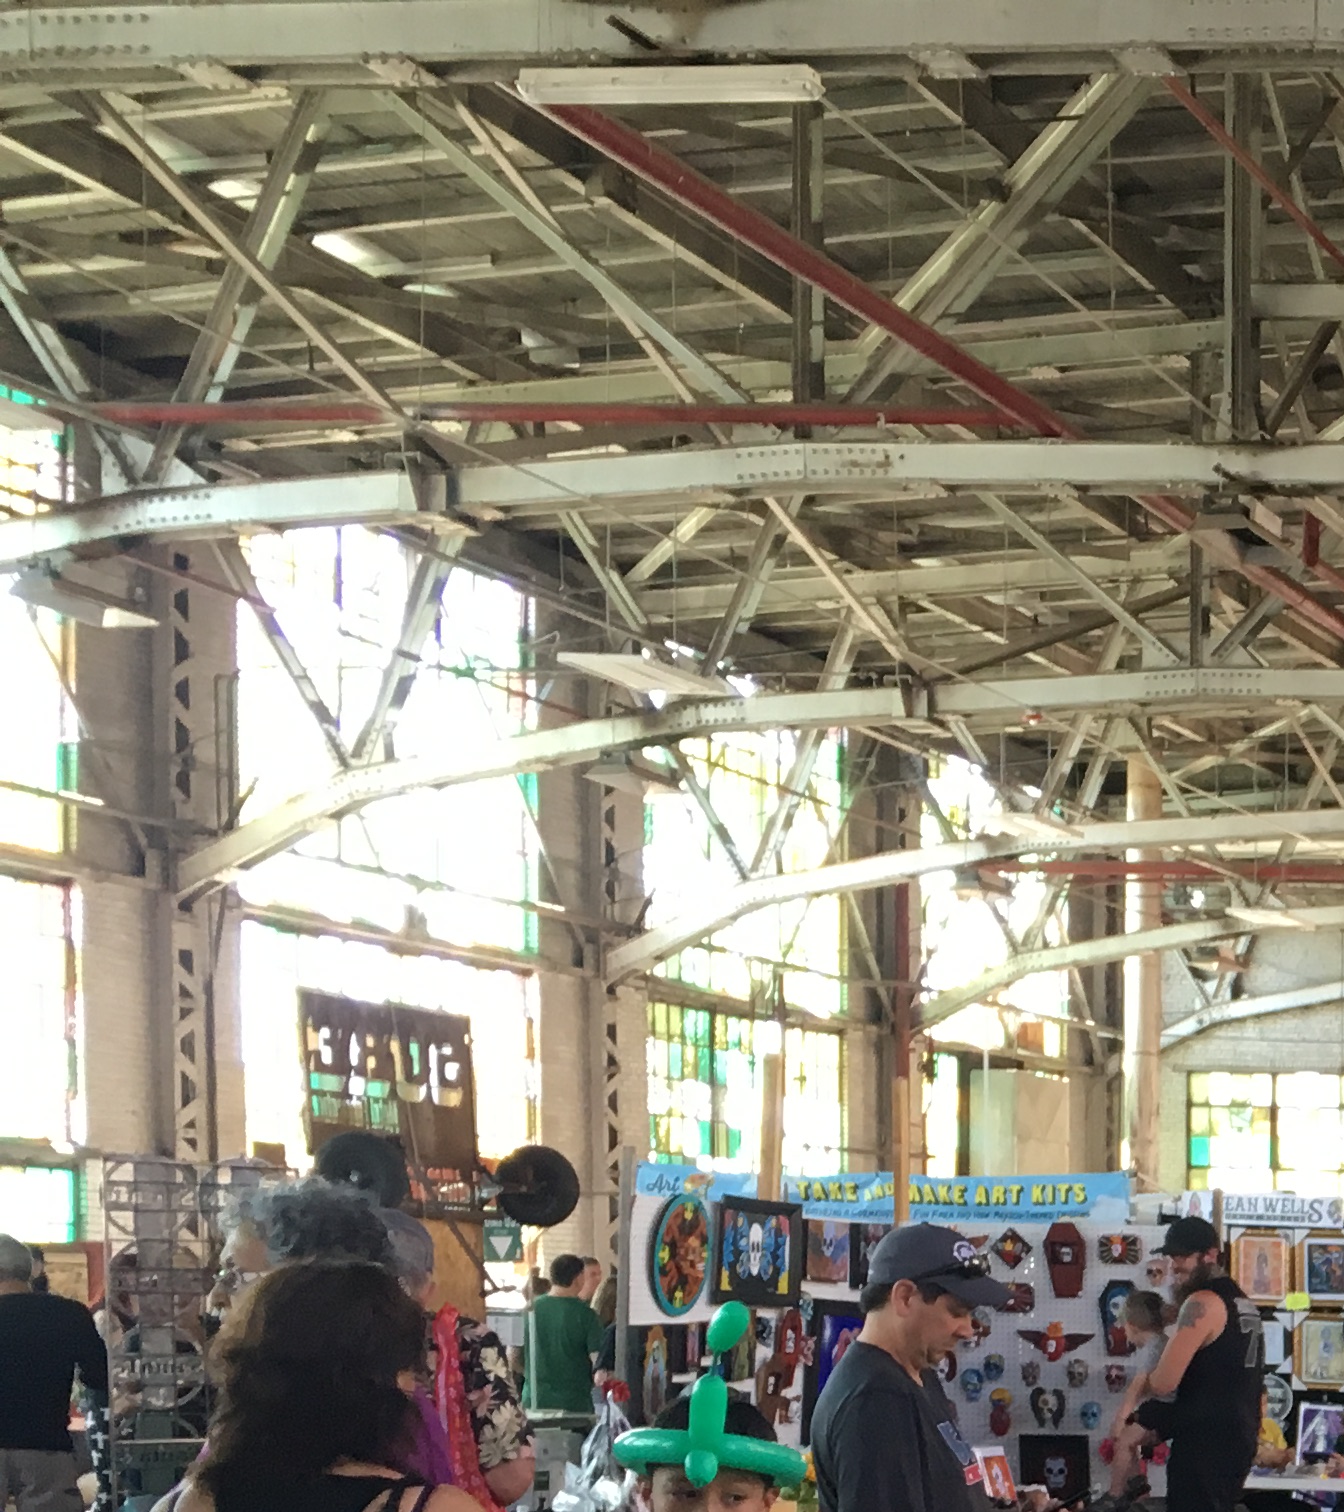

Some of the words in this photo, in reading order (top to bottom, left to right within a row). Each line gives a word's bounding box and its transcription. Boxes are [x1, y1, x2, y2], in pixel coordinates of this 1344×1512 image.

[797, 1181, 859, 1203] TAKE
[909, 1184, 967, 1206] MAKE
[975, 1184, 1024, 1206] ART
[1032, 1183, 1087, 1206] KITS
[1263, 1196, 1324, 1223] WELLS
